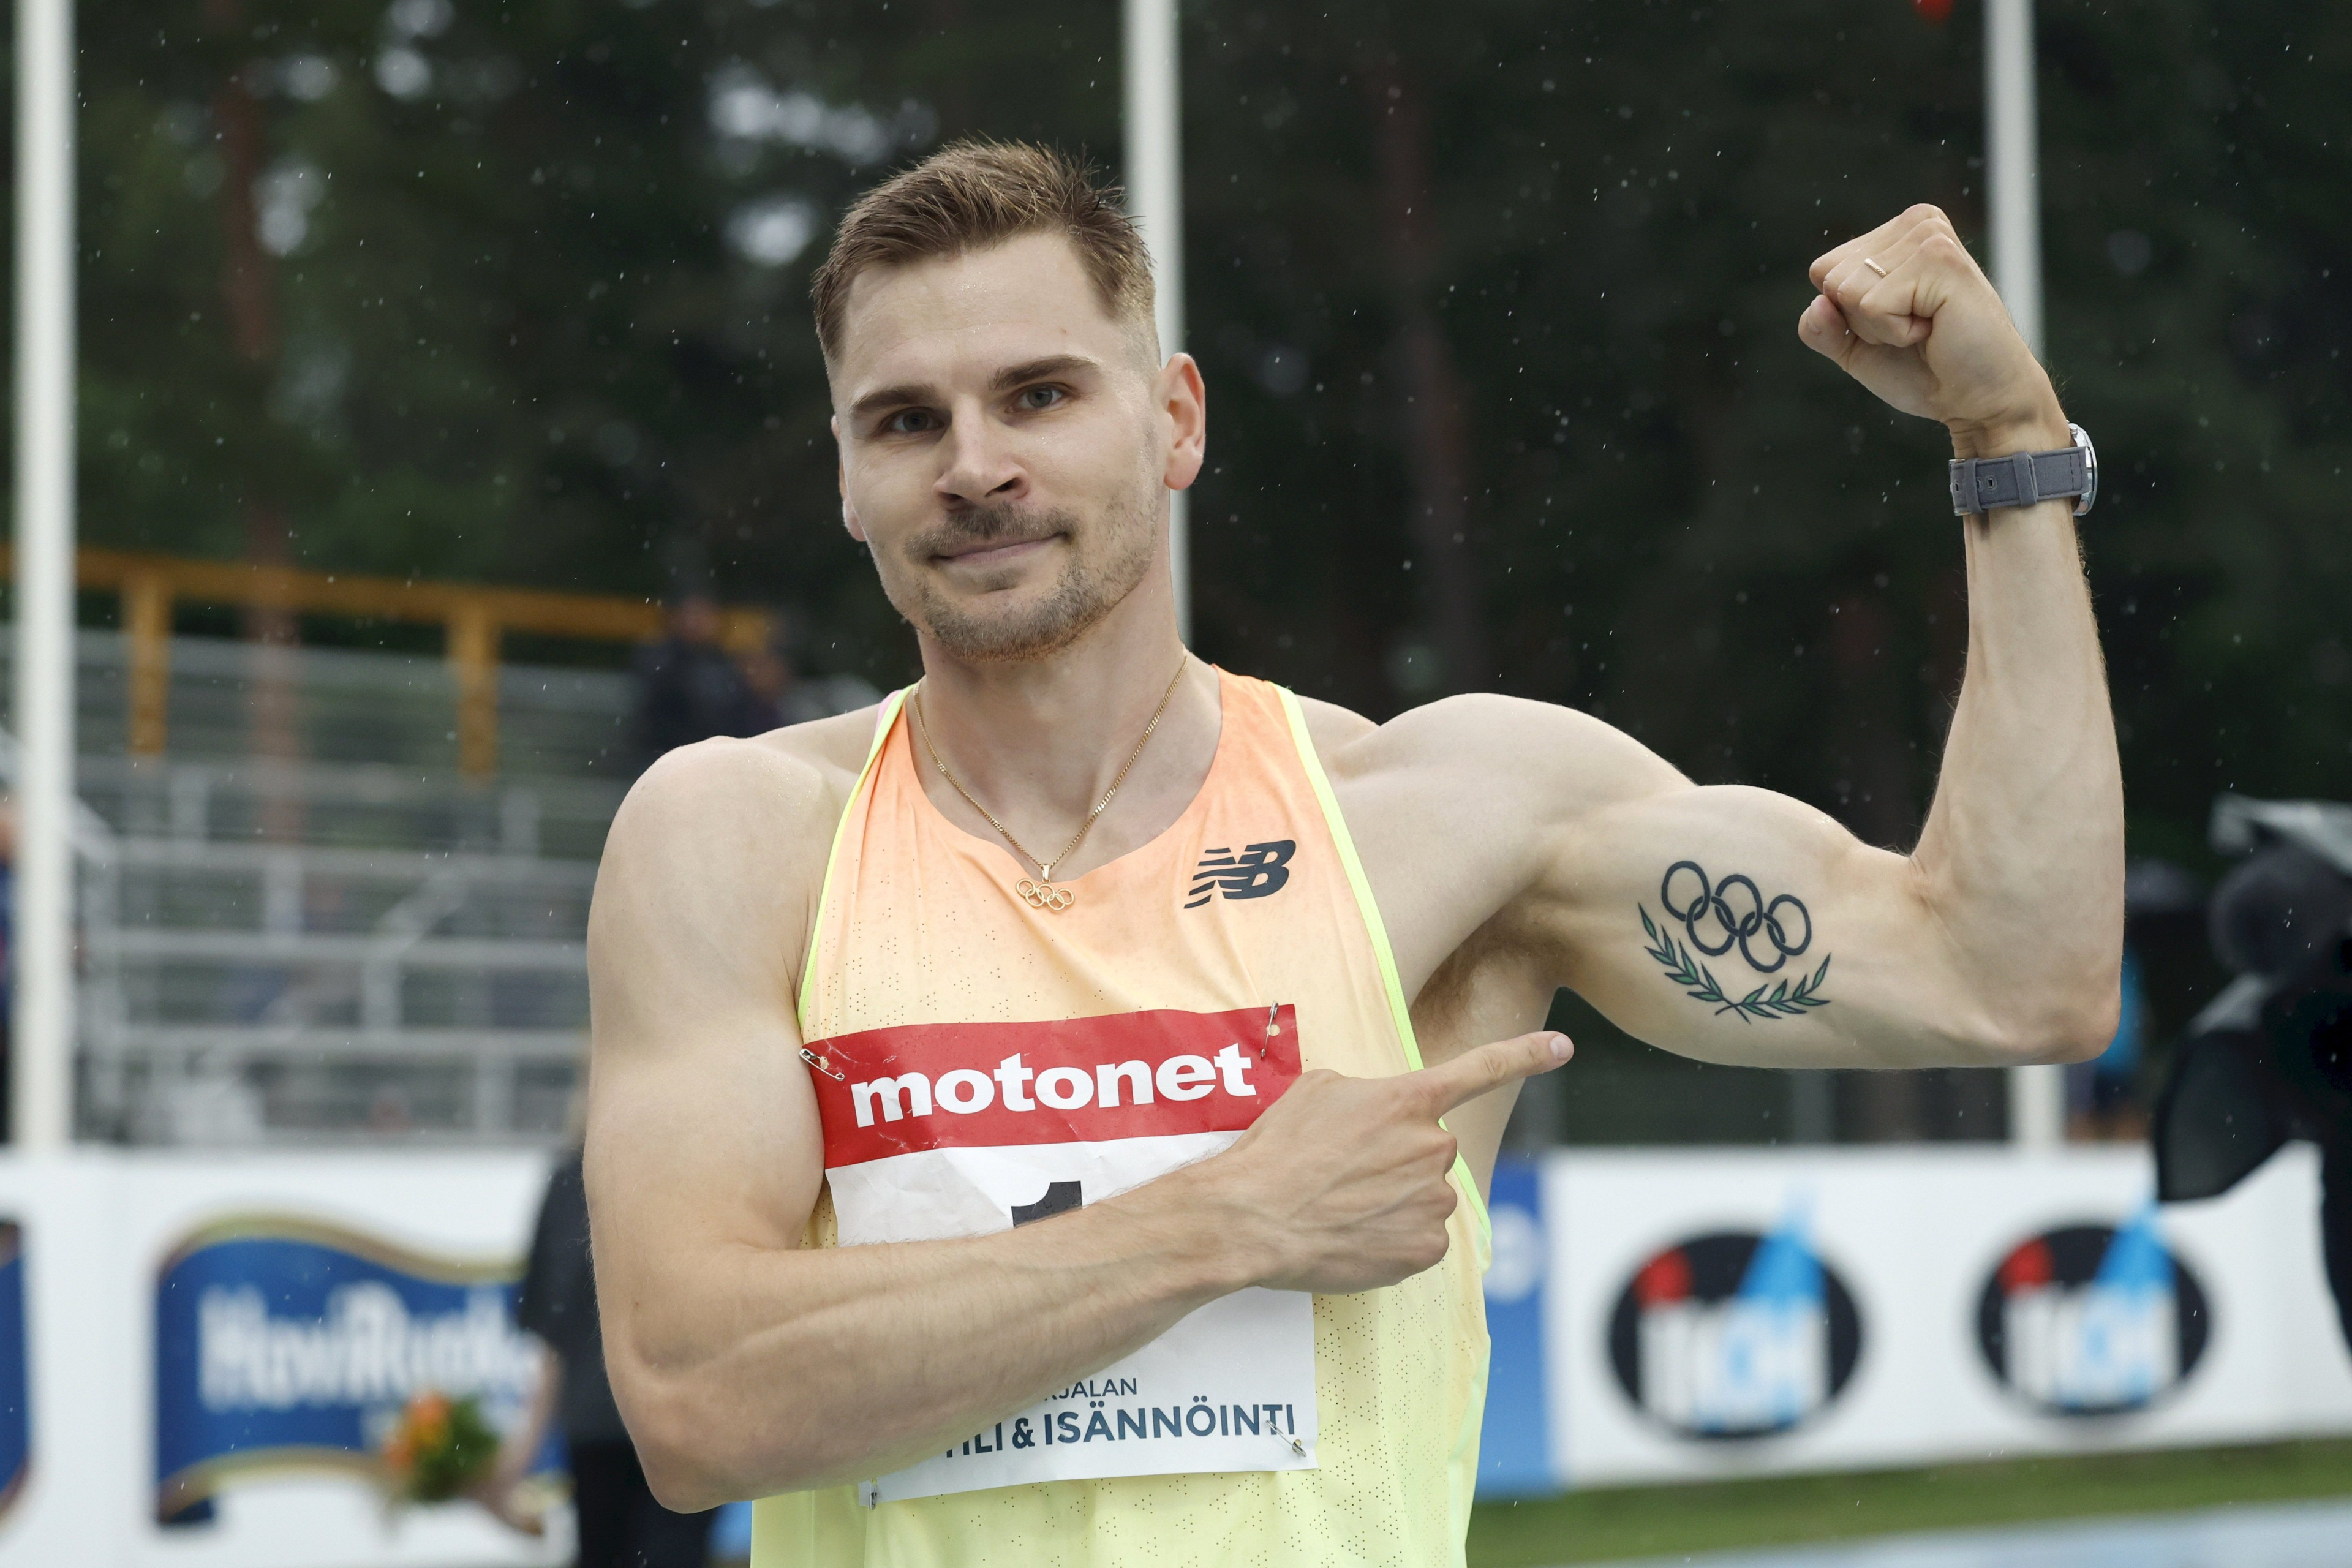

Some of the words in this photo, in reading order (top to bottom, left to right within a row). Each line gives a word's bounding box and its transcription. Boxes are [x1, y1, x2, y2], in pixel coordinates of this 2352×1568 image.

[850, 1042, 1257, 1128] motonet
[1044, 1378, 1137, 1401] JALAN
[946, 1421, 1003, 1458] LI
[1012, 1417, 1036, 1449] &
[1044, 1395, 1295, 1446] ISÄNNÖINTI
